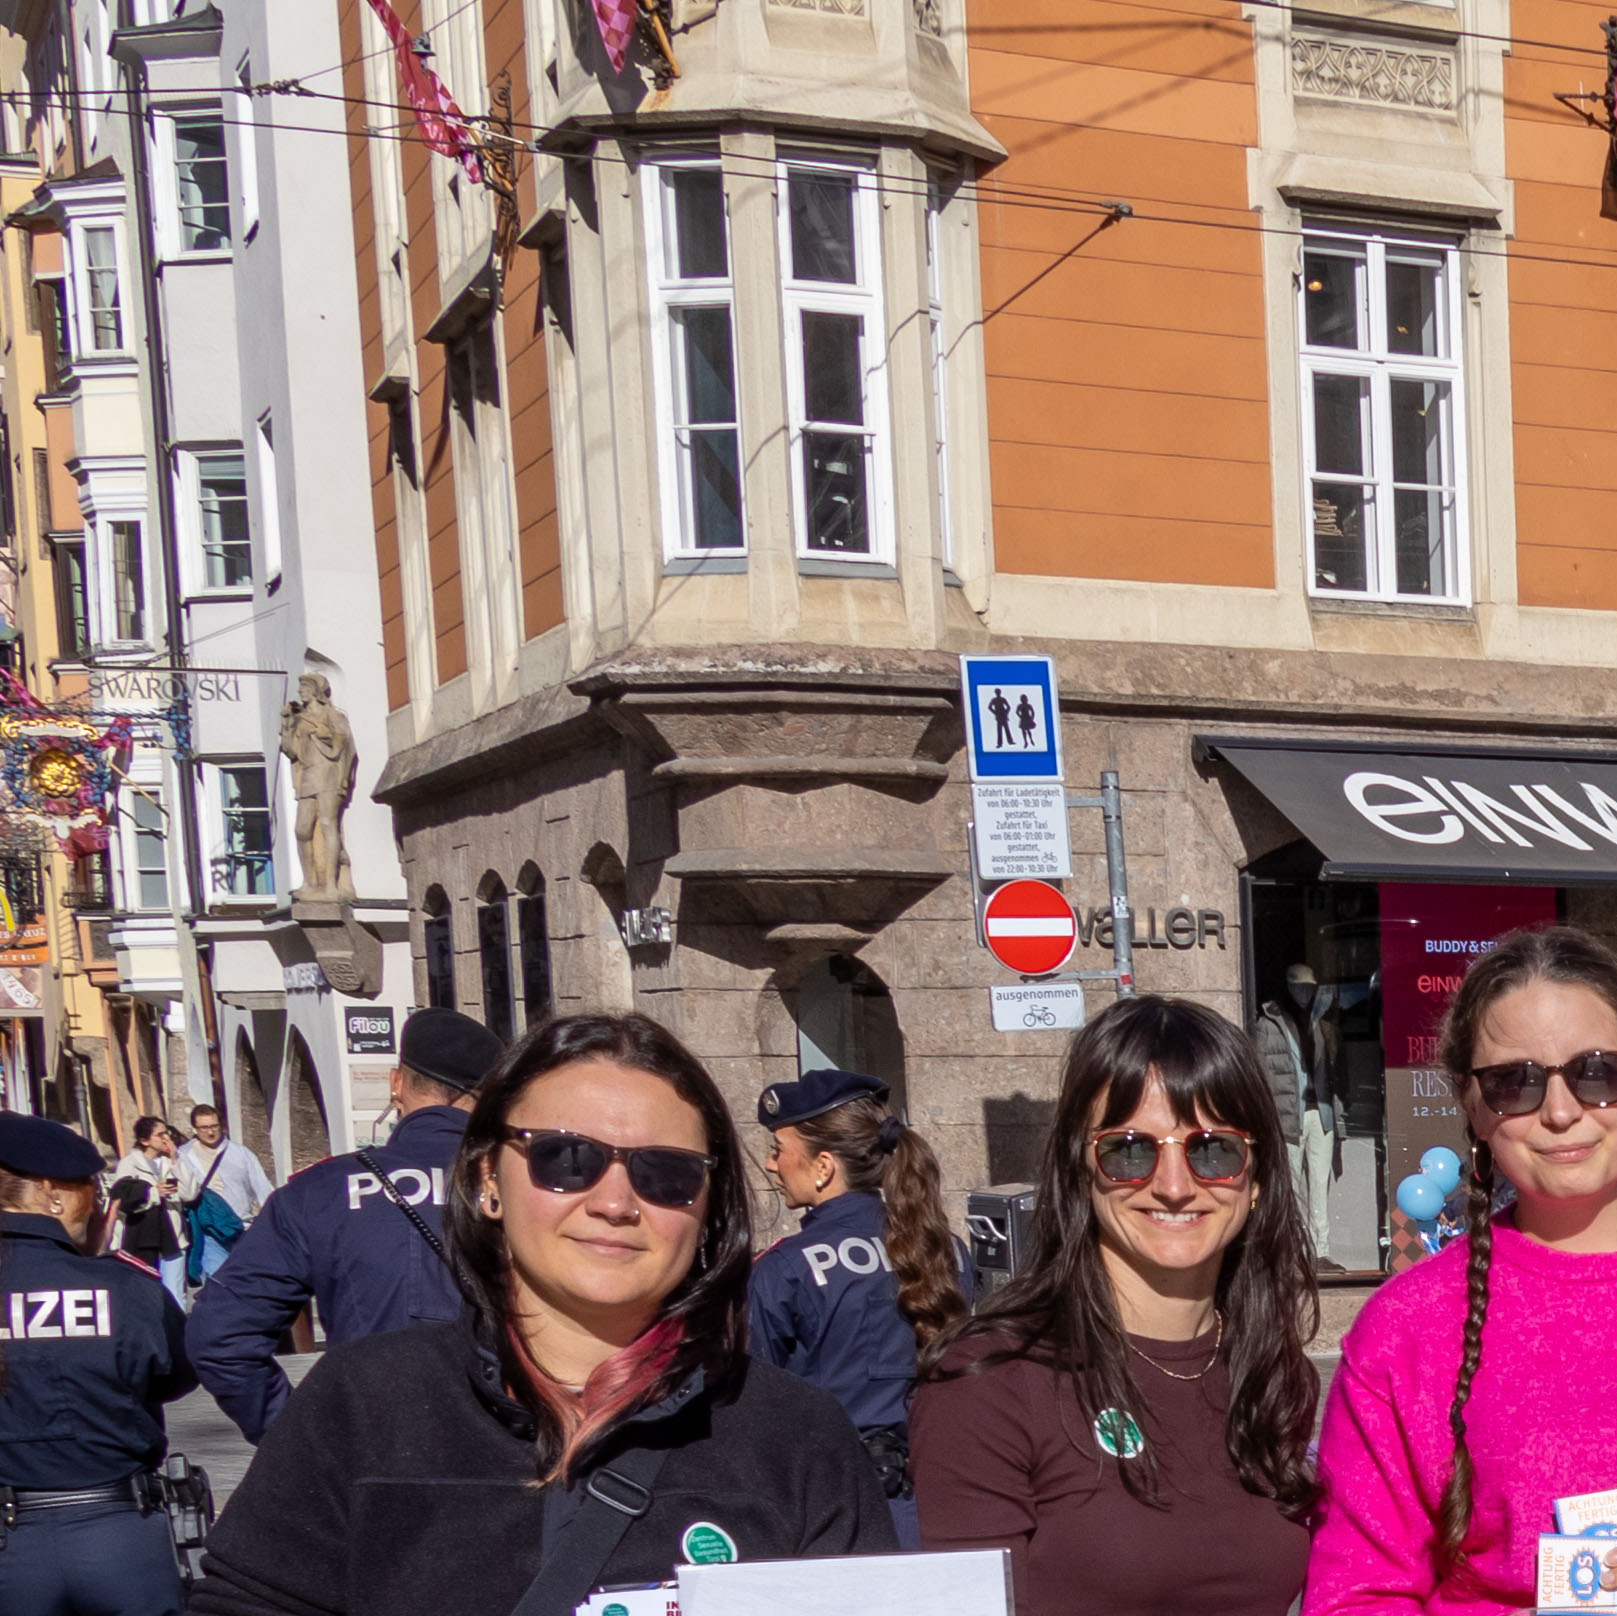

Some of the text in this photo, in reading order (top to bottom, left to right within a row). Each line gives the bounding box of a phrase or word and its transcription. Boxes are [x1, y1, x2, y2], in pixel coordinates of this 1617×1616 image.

[89, 674, 241, 702] SWAROVSKI
[978, 788, 1060, 798] Zufahrt für Ladetätigkeit
[1041, 799, 1052, 807] Uhr
[996, 821, 1048, 830] Zufahrt für Taxi
[1044, 832, 1055, 840] Uhr
[992, 855, 1039, 864] ausgenommen
[996, 988, 1078, 1002] ausgenommen
[350, 1017, 390, 1034] Filou
[0, 1289, 111, 1340] IZEI
[1542, 1547, 1553, 1602] ACHTUNG
[1554, 1555, 1565, 1595] FERTIG
[1577, 1555, 1594, 1595] LOS
